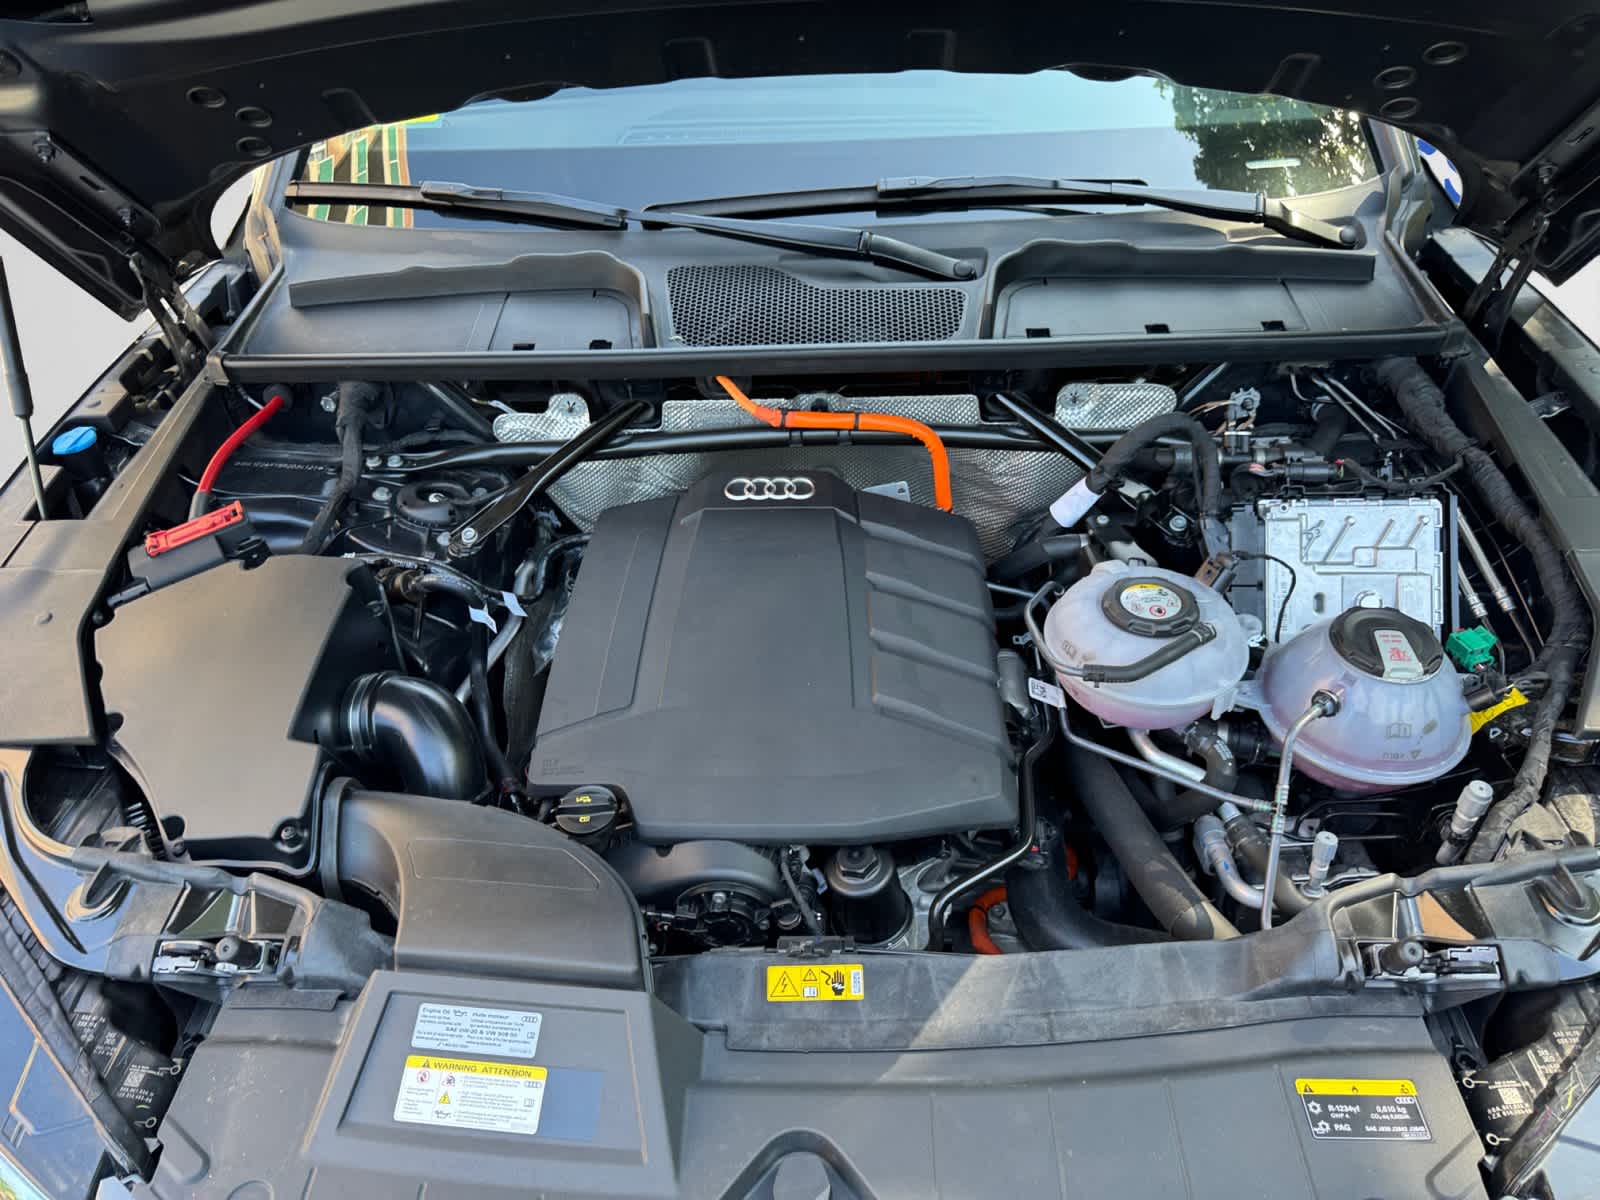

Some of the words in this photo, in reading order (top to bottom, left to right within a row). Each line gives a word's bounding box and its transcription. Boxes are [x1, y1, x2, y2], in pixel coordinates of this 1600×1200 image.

[422, 1007, 441, 1015] Engine
[434, 1061, 477, 1073] WARNING
[481, 1066, 532, 1078] ATTENTION
[1327, 1104, 1361, 1114] R-1234yf
[1396, 1105, 1408, 1114] kg
[1334, 1123, 1352, 1131] PAG
